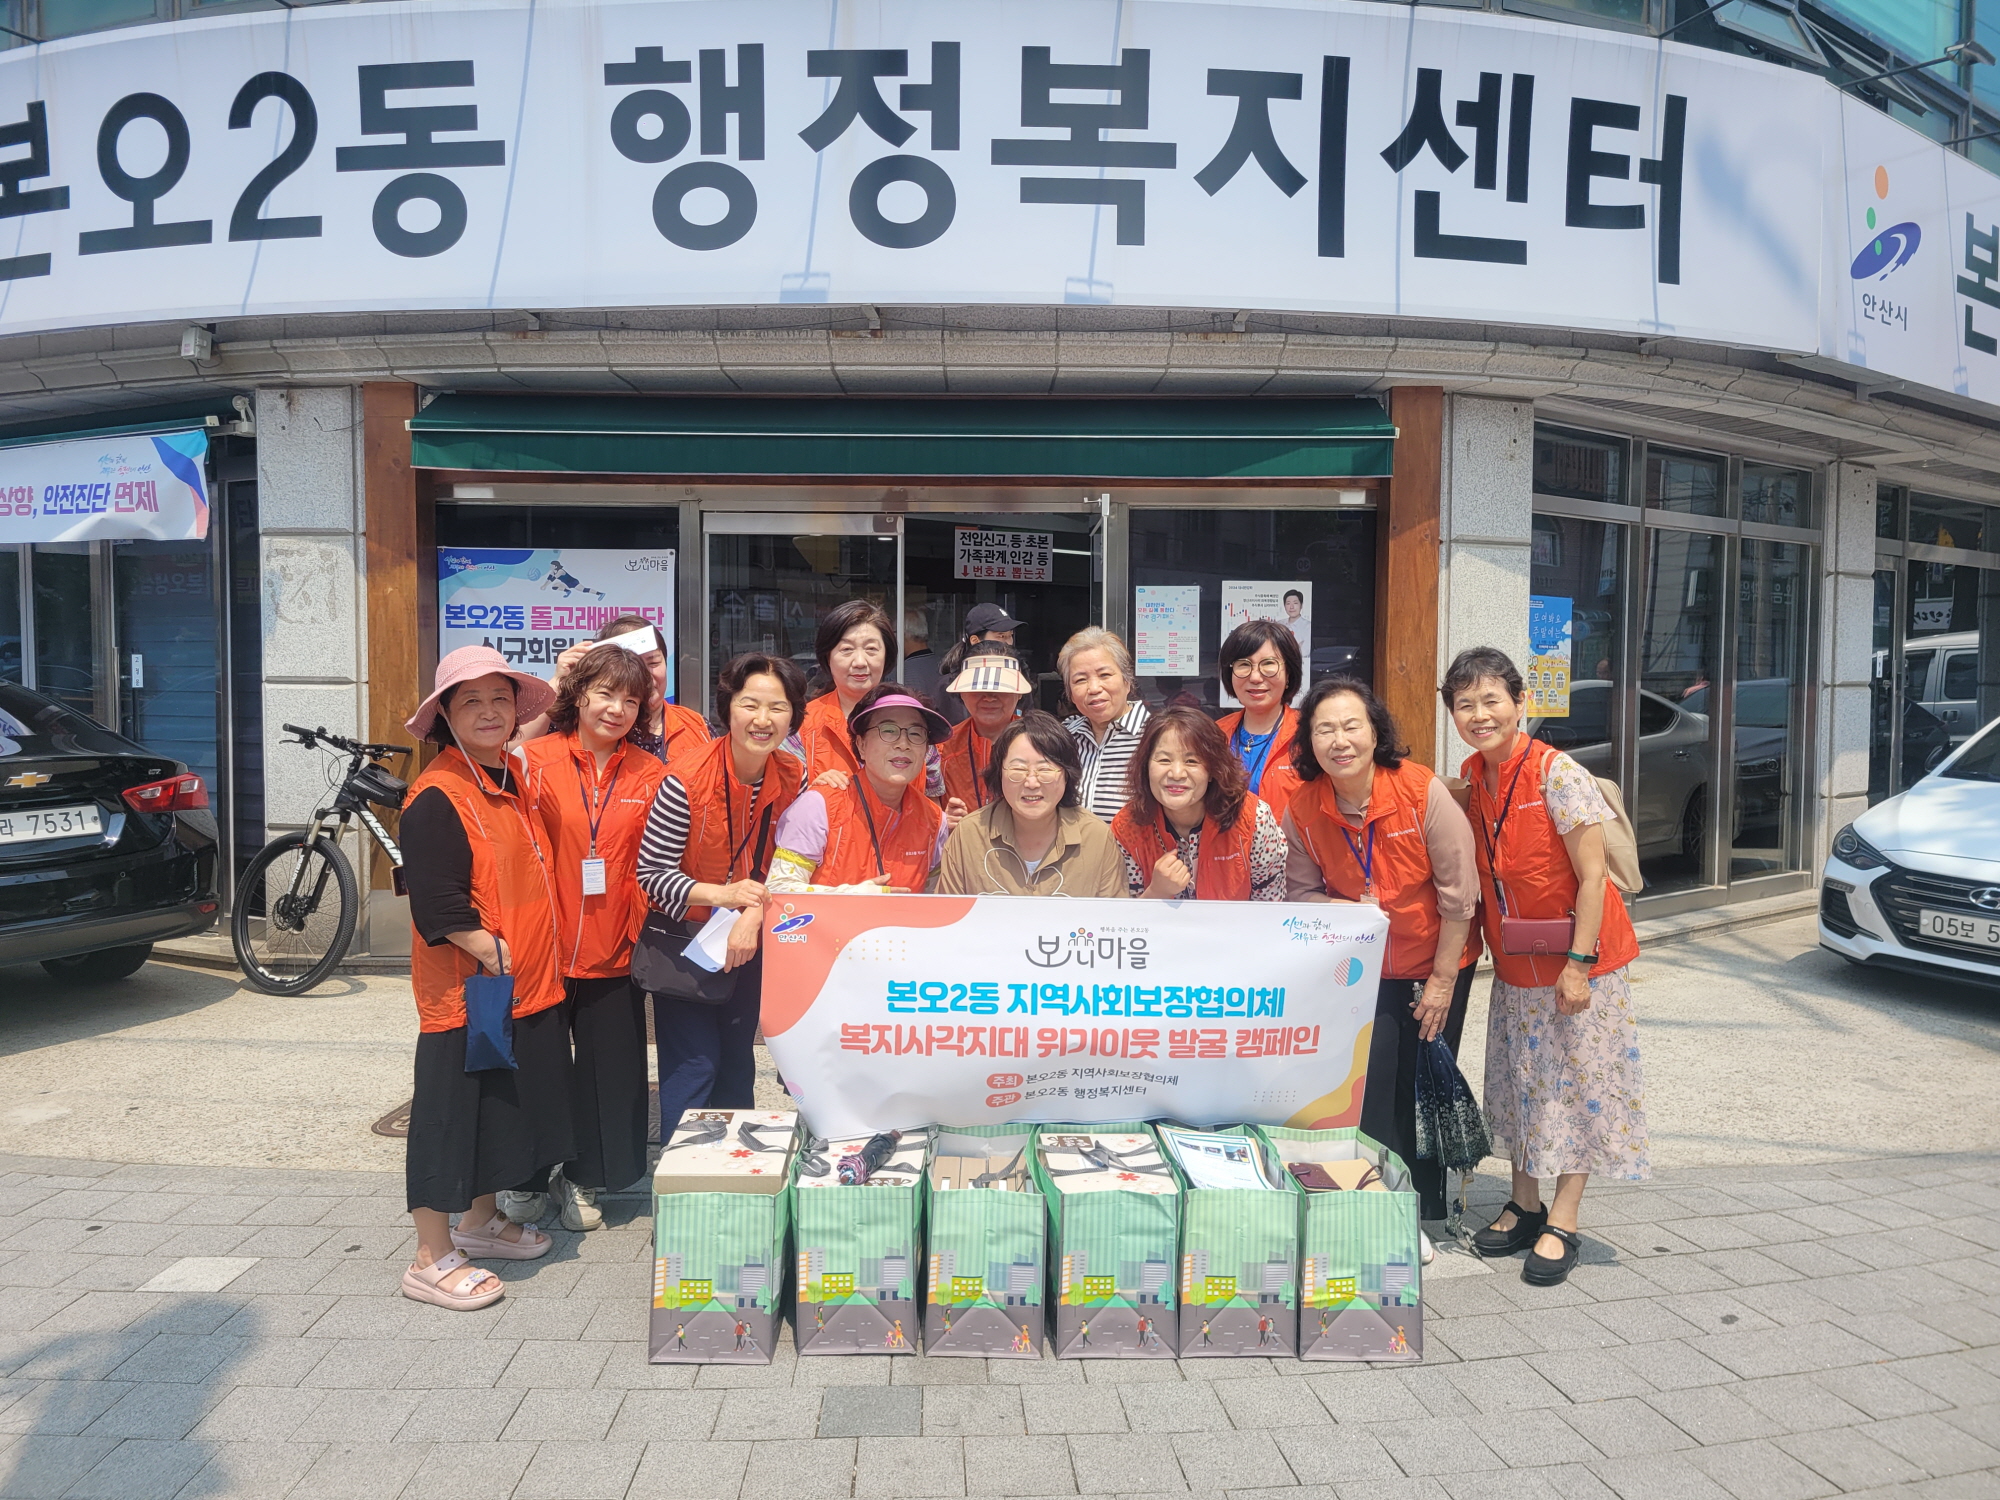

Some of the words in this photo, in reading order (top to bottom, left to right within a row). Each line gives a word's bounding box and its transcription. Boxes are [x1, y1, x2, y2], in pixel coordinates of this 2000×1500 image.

[604, 41, 1688, 286] 행정복지센터
[1862, 293, 1908, 332] 안산시
[43, 482, 111, 515] 안전진단
[114, 480, 160, 513] 면제
[973, 565, 1007, 578] 번호표
[1037, 552, 1049, 566] 등
[445, 604, 525, 631] 본오2동
[26, 810, 85, 836] 7531
[778, 934, 808, 943] 안산시
[1355, 932, 1378, 944] 안산
[1932, 915, 1975, 939] 05보
[887, 980, 1000, 1014] 본오2동
[1007, 983, 1286, 1018] 지역사회보장협의체
[840, 1023, 1029, 1058] 복지사각지대
[1036, 1027, 1160, 1059] 위기이웃
[1168, 1028, 1228, 1059] 발굴
[1235, 1024, 1320, 1058] 캠페인
[992, 1075, 1017, 1087] 주최
[1025, 1069, 1068, 1085] 본오2동
[1071, 1067, 1179, 1086] 지역사회보장협의체
[991, 1094, 1016, 1106] 주관
[1024, 1086, 1069, 1100] 본오2동
[1073, 1085, 1147, 1100] 행정복지센터
